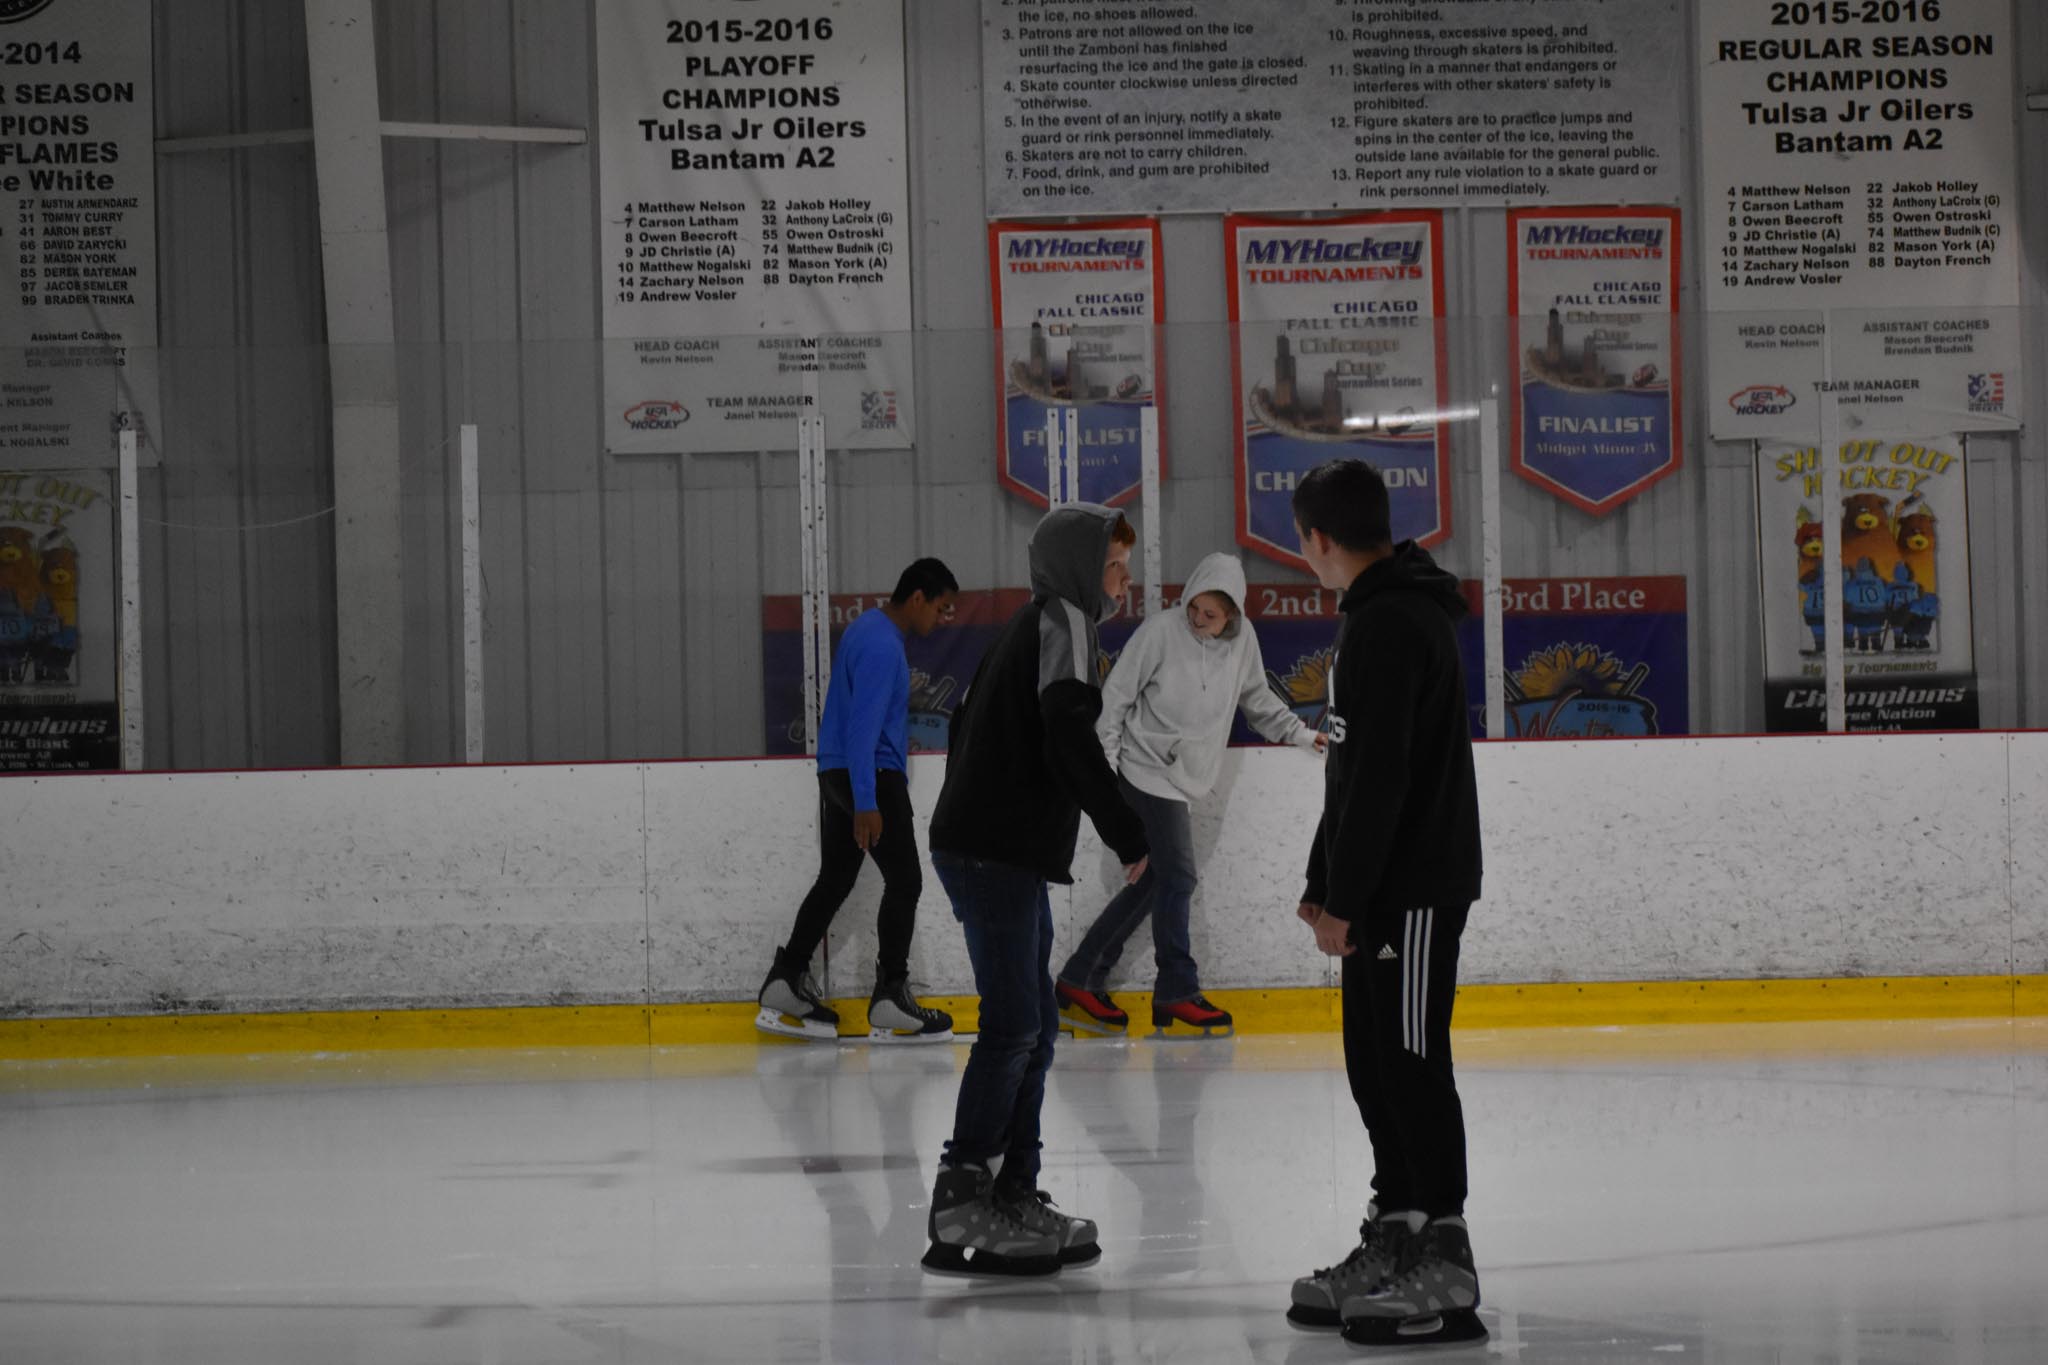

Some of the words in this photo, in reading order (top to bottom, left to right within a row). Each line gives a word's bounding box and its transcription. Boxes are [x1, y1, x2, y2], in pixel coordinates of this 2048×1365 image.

[1771, 1, 1940, 25] 2015-2016
[667, 17, 834, 43] 2015-2016
[1019, 27, 1072, 39] Patrons
[1076, 27, 1098, 39] are
[1102, 26, 1125, 38] not
[1128, 24, 1182, 37] allowed
[1187, 25, 1204, 36] on
[1208, 23, 1229, 34] the
[1234, 23, 1253, 34] ice
[1352, 27, 1436, 42] Roughness,
[1439, 26, 1507, 39] excessive
[1511, 25, 1557, 40] speed,
[1562, 25, 1588, 37] and
[1353, 45, 1409, 59] weaving
[1414, 44, 1467, 58] through
[1472, 43, 1523, 56] skaters
[1527, 43, 1539, 54] is
[1543, 41, 1617, 56] prohibited.
[1719, 38, 1862, 61] REGULAR
[1872, 35, 1993, 58] SEASON
[685, 54, 815, 77] PLAYOFF
[1020, 80, 1058, 92] Skate
[1063, 79, 1116, 91] counter
[1120, 76, 1188, 90] clockwise
[1192, 76, 1238, 88] unless
[1242, 74, 1298, 87] directed
[1767, 68, 1948, 93] CHAMPIONS
[15, 82, 134, 104] SEASON
[663, 86, 841, 109] CHAMPIONS
[1742, 101, 1827, 125] Tulsa
[1838, 100, 1870, 123] Jr
[1880, 98, 1973, 121] Oilers
[638, 119, 722, 141] Tulsa
[731, 119, 763, 141] Jr
[773, 117, 866, 139] Oilers
[1775, 131, 1892, 153] Bantam
[1903, 128, 1943, 150] A2
[0, 141, 118, 164] FLAMES
[671, 148, 785, 170] Bantam
[796, 147, 835, 168] A2
[1022, 150, 1074, 163] Skaters
[1078, 150, 1100, 161] are
[1104, 148, 1127, 160] not
[1131, 148, 1144, 159] to
[1148, 148, 1182, 161] carry
[1187, 145, 1247, 158] children.
[29, 170, 114, 191] White
[1355, 167, 1401, 183] Report
[1406, 168, 1430, 181] any
[1435, 166, 1461, 179] rule
[1466, 164, 1524, 178] violation
[1528, 165, 1541, 177] to
[1546, 166, 1554, 177] a
[1558, 164, 1595, 176] skate
[1599, 163, 1639, 178] guard
[1643, 165, 1657, 175] or
[1867, 182, 1883, 194] 22
[1892, 182, 1932, 193] Jakob
[1937, 181, 1978, 194] Holley
[625, 203, 632, 213] 4
[638, 202, 695, 213] Matthew
[700, 201, 746, 212] Nelson
[42, 213, 80, 222] TOMMY
[85, 212, 123, 222] CURRY
[639, 217, 685, 227] Carson
[690, 216, 739, 227] Latham
[1868, 213, 1884, 223] 55
[1893, 212, 1931, 223] Owen
[1935, 210, 1991, 222] Ostroski
[639, 232, 677, 242] Owen
[681, 230, 737, 242] Beecroft
[1527, 226, 1664, 248] MYHockey
[639, 247, 656, 257] JD
[661, 246, 712, 257] Christie
[716, 246, 735, 258] (A)
[1008, 236, 1145, 259] MYHockey
[1246, 237, 1424, 264] MYHockey
[1527, 248, 1663, 260] TOURNAMENTS
[1868, 242, 1884, 253] 82
[1894, 241, 1937, 252] Mason
[1941, 241, 1971, 251] York
[1976, 240, 1995, 253] (A)
[618, 262, 633, 272] 10
[640, 261, 693, 271] Matthew
[698, 260, 751, 273] Nogalski
[1008, 260, 1145, 274] TOURNAMENTS
[1868, 257, 1884, 268] 88
[1894, 256, 1941, 269] Dayton
[1945, 255, 1991, 266] French
[44, 268, 80, 277] DEREK
[84, 267, 136, 276] BATEMAN
[1247, 266, 1423, 284] TOURNAMENTS
[618, 276, 634, 287] 14
[640, 276, 694, 288] Zachary
[698, 275, 744, 286] Nelson
[1593, 281, 1662, 292] CHICAGO
[93, 295, 134, 304] TRINKA
[619, 291, 634, 301] 19
[640, 290, 691, 301] Andrew
[1075, 292, 1145, 305] CHICAGO
[1556, 295, 1592, 305] FALL
[1598, 294, 1662, 304] CLASSIC
[1038, 307, 1075, 318] FALL
[1080, 305, 1145, 317] CLASSIC
[1334, 300, 1418, 314] CHICAGO
[1287, 318, 1330, 331] FALL
[1341, 315, 1419, 329] CLASSIC
[1738, 325, 1775, 336] HEAD
[1780, 325, 1825, 335] COACH
[1863, 322, 1929, 332] ASSISTANT
[1933, 320, 1990, 330] COACHES
[634, 341, 670, 352] HEAD
[674, 341, 719, 350] COACH
[827, 338, 882, 348] COACHES
[1813, 381, 1849, 392] TEAM
[1854, 379, 1920, 390] MANAGER
[706, 397, 743, 407] TEAM
[748, 396, 813, 407] MANAGER
[1737, 405, 1786, 415] HOCKEY
[1539, 416, 1654, 434] FINALIST
[1776, 439, 1884, 481] SHOT
[1889, 442, 1958, 474] OUT
[1804, 466, 1930, 497] HCKEY
[1262, 589, 1321, 616] 2nd
[1560, 582, 1645, 610] Place
[1784, 686, 1966, 708] Chmpions
[1878, 708, 1936, 720] Nation
